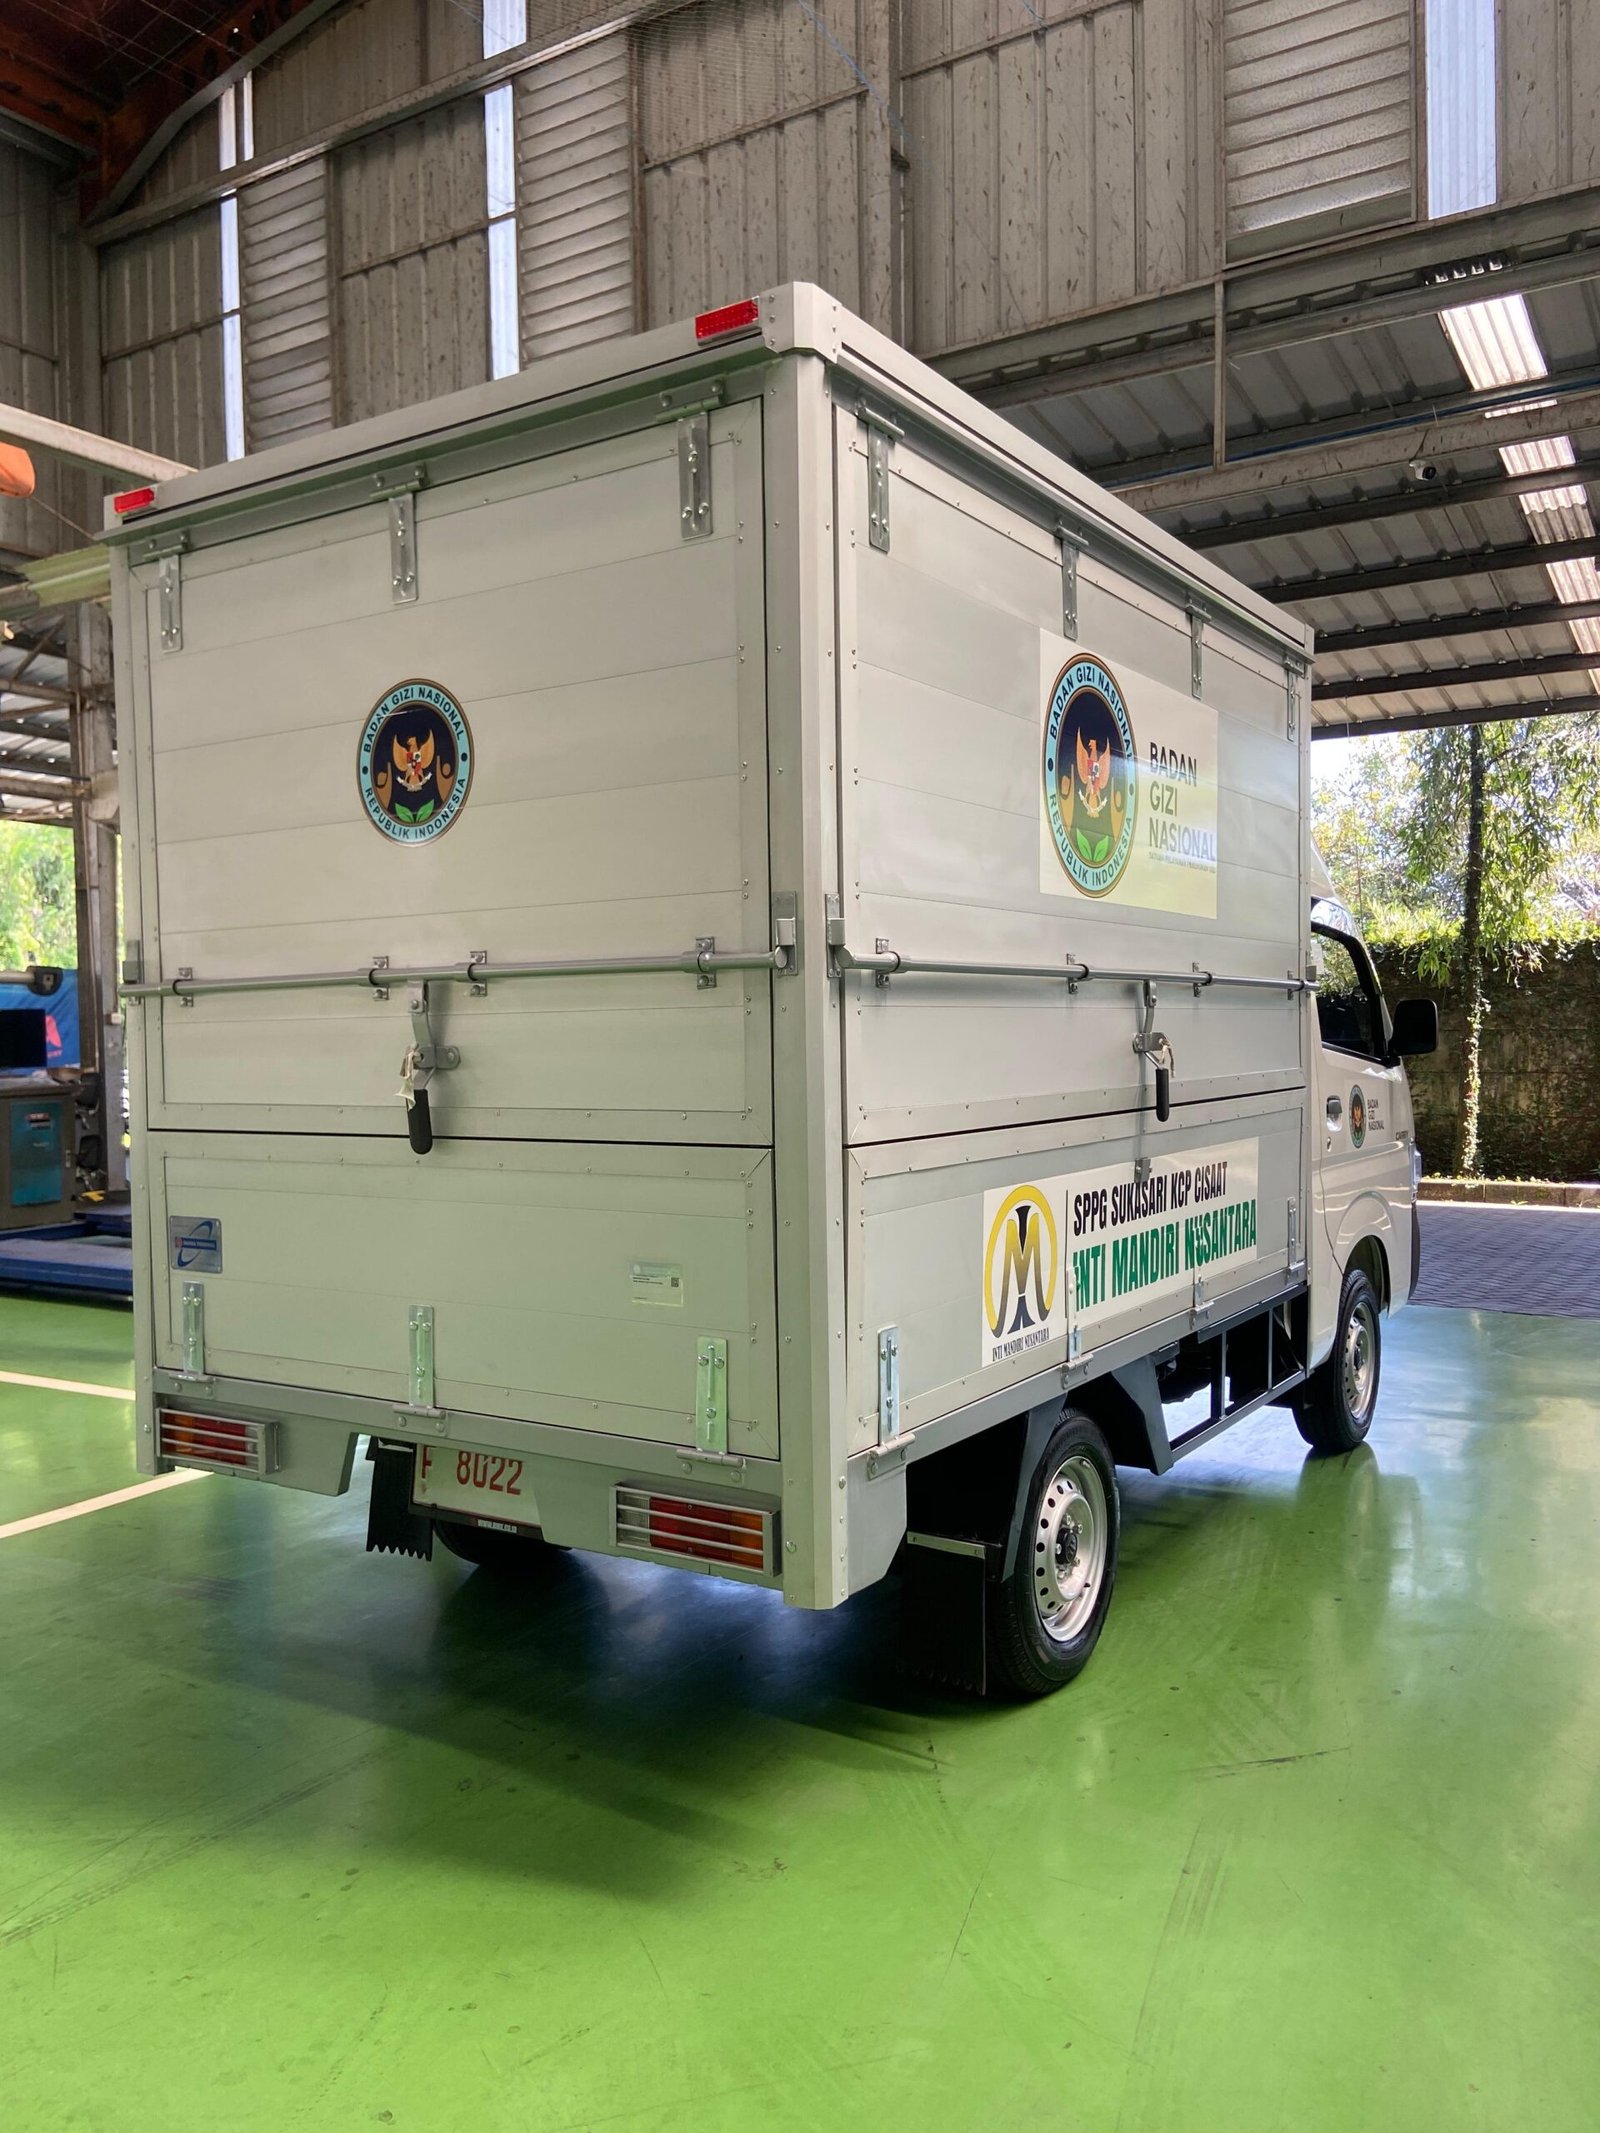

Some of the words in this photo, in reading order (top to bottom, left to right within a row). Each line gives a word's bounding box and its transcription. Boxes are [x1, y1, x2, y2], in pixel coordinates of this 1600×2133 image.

[364, 704, 389, 754] BADAN
[392, 688, 414, 705] GIZI
[418, 687, 465, 741] NASIONAL
[1050, 677, 1074, 741] BADAN
[1076, 666, 1095, 684] GIZI
[1150, 742, 1197, 787] BADAN
[365, 787, 410, 839] REPUBLIK
[414, 778, 466, 839] INDONESIA
[1150, 781, 1178, 816] GIZI
[1050, 793, 1088, 884] REPUBLIK
[1092, 816, 1132, 887] INDONESIA
[1149, 816, 1216, 862] NASIONAL
[1073, 1188, 1107, 1236] SPPG
[1111, 1175, 1167, 1227] SUKASARI
[1171, 1170, 1191, 1209] KCP
[1194, 1161, 1228, 1203] CISAAT
[1073, 1243, 1106, 1312] INTI
[1112, 1221, 1179, 1298] MANDIRI
[1185, 1199, 1257, 1271] NUSANTARA
[456, 1450, 524, 1495] 8022
